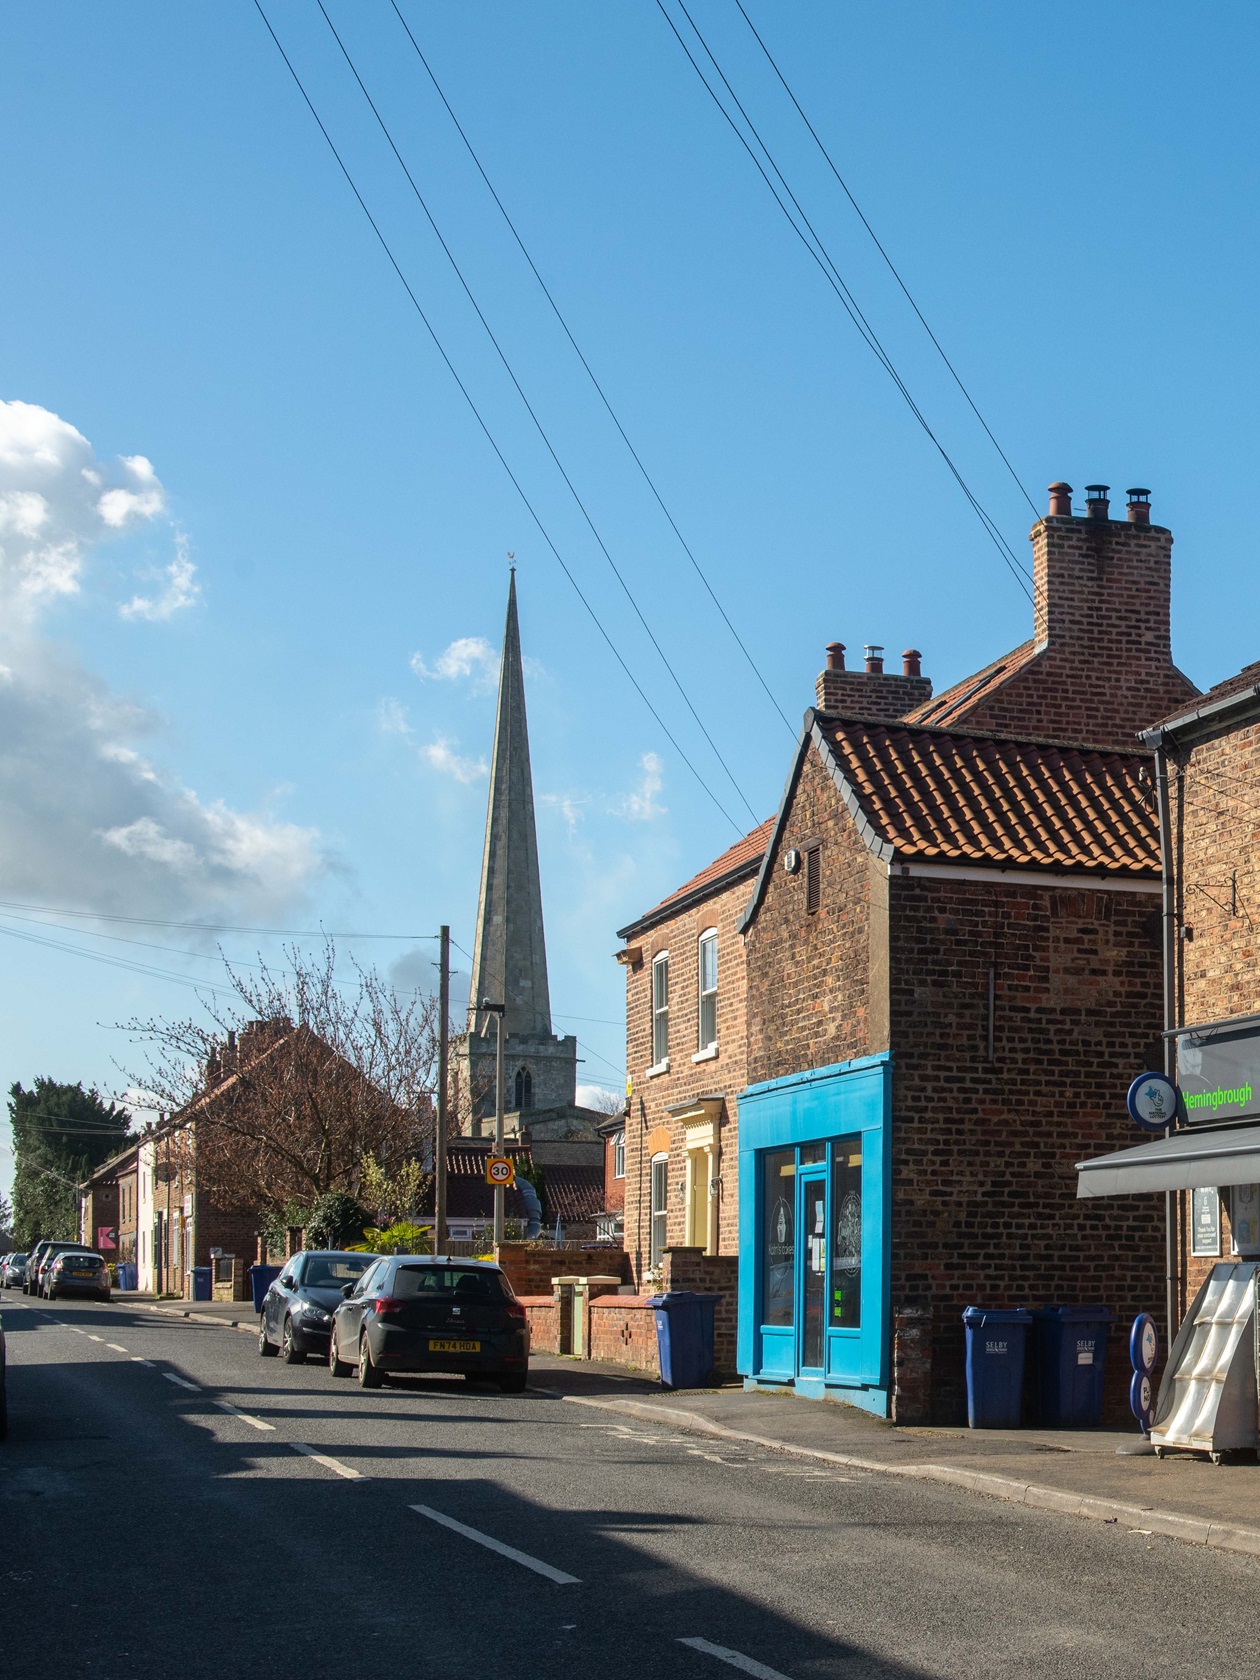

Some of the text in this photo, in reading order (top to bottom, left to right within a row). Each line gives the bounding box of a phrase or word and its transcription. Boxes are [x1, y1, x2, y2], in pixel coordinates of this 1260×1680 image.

[1182, 1081, 1252, 1111] Hemingbrough
[493, 1166, 509, 1176] 30
[433, 1341, 456, 1350] FN74
